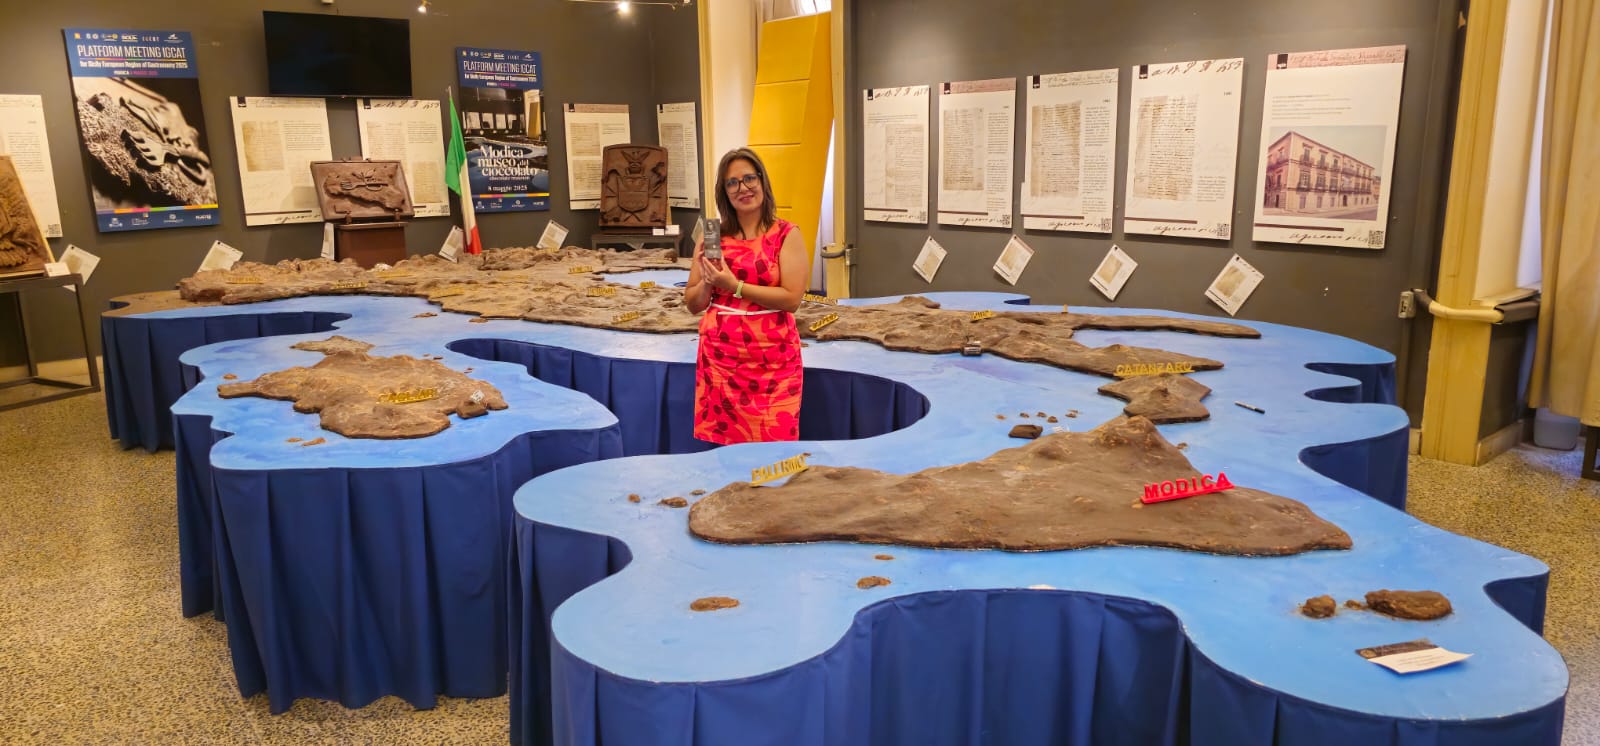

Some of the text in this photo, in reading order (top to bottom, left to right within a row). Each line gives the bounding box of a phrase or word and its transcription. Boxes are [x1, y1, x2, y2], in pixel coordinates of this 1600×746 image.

[77, 44, 186, 59] PLATFORM MEETING IGCAT
[463, 60, 536, 74] PLATFORM MEETING IGCAT
[480, 145, 523, 158] Modica
[477, 157, 516, 168] museo
[481, 164, 537, 177] cioccolato
[1115, 361, 1192, 375] CATANZARO
[751, 452, 807, 483] PALERMO
[1144, 471, 1232, 499] MODICA
